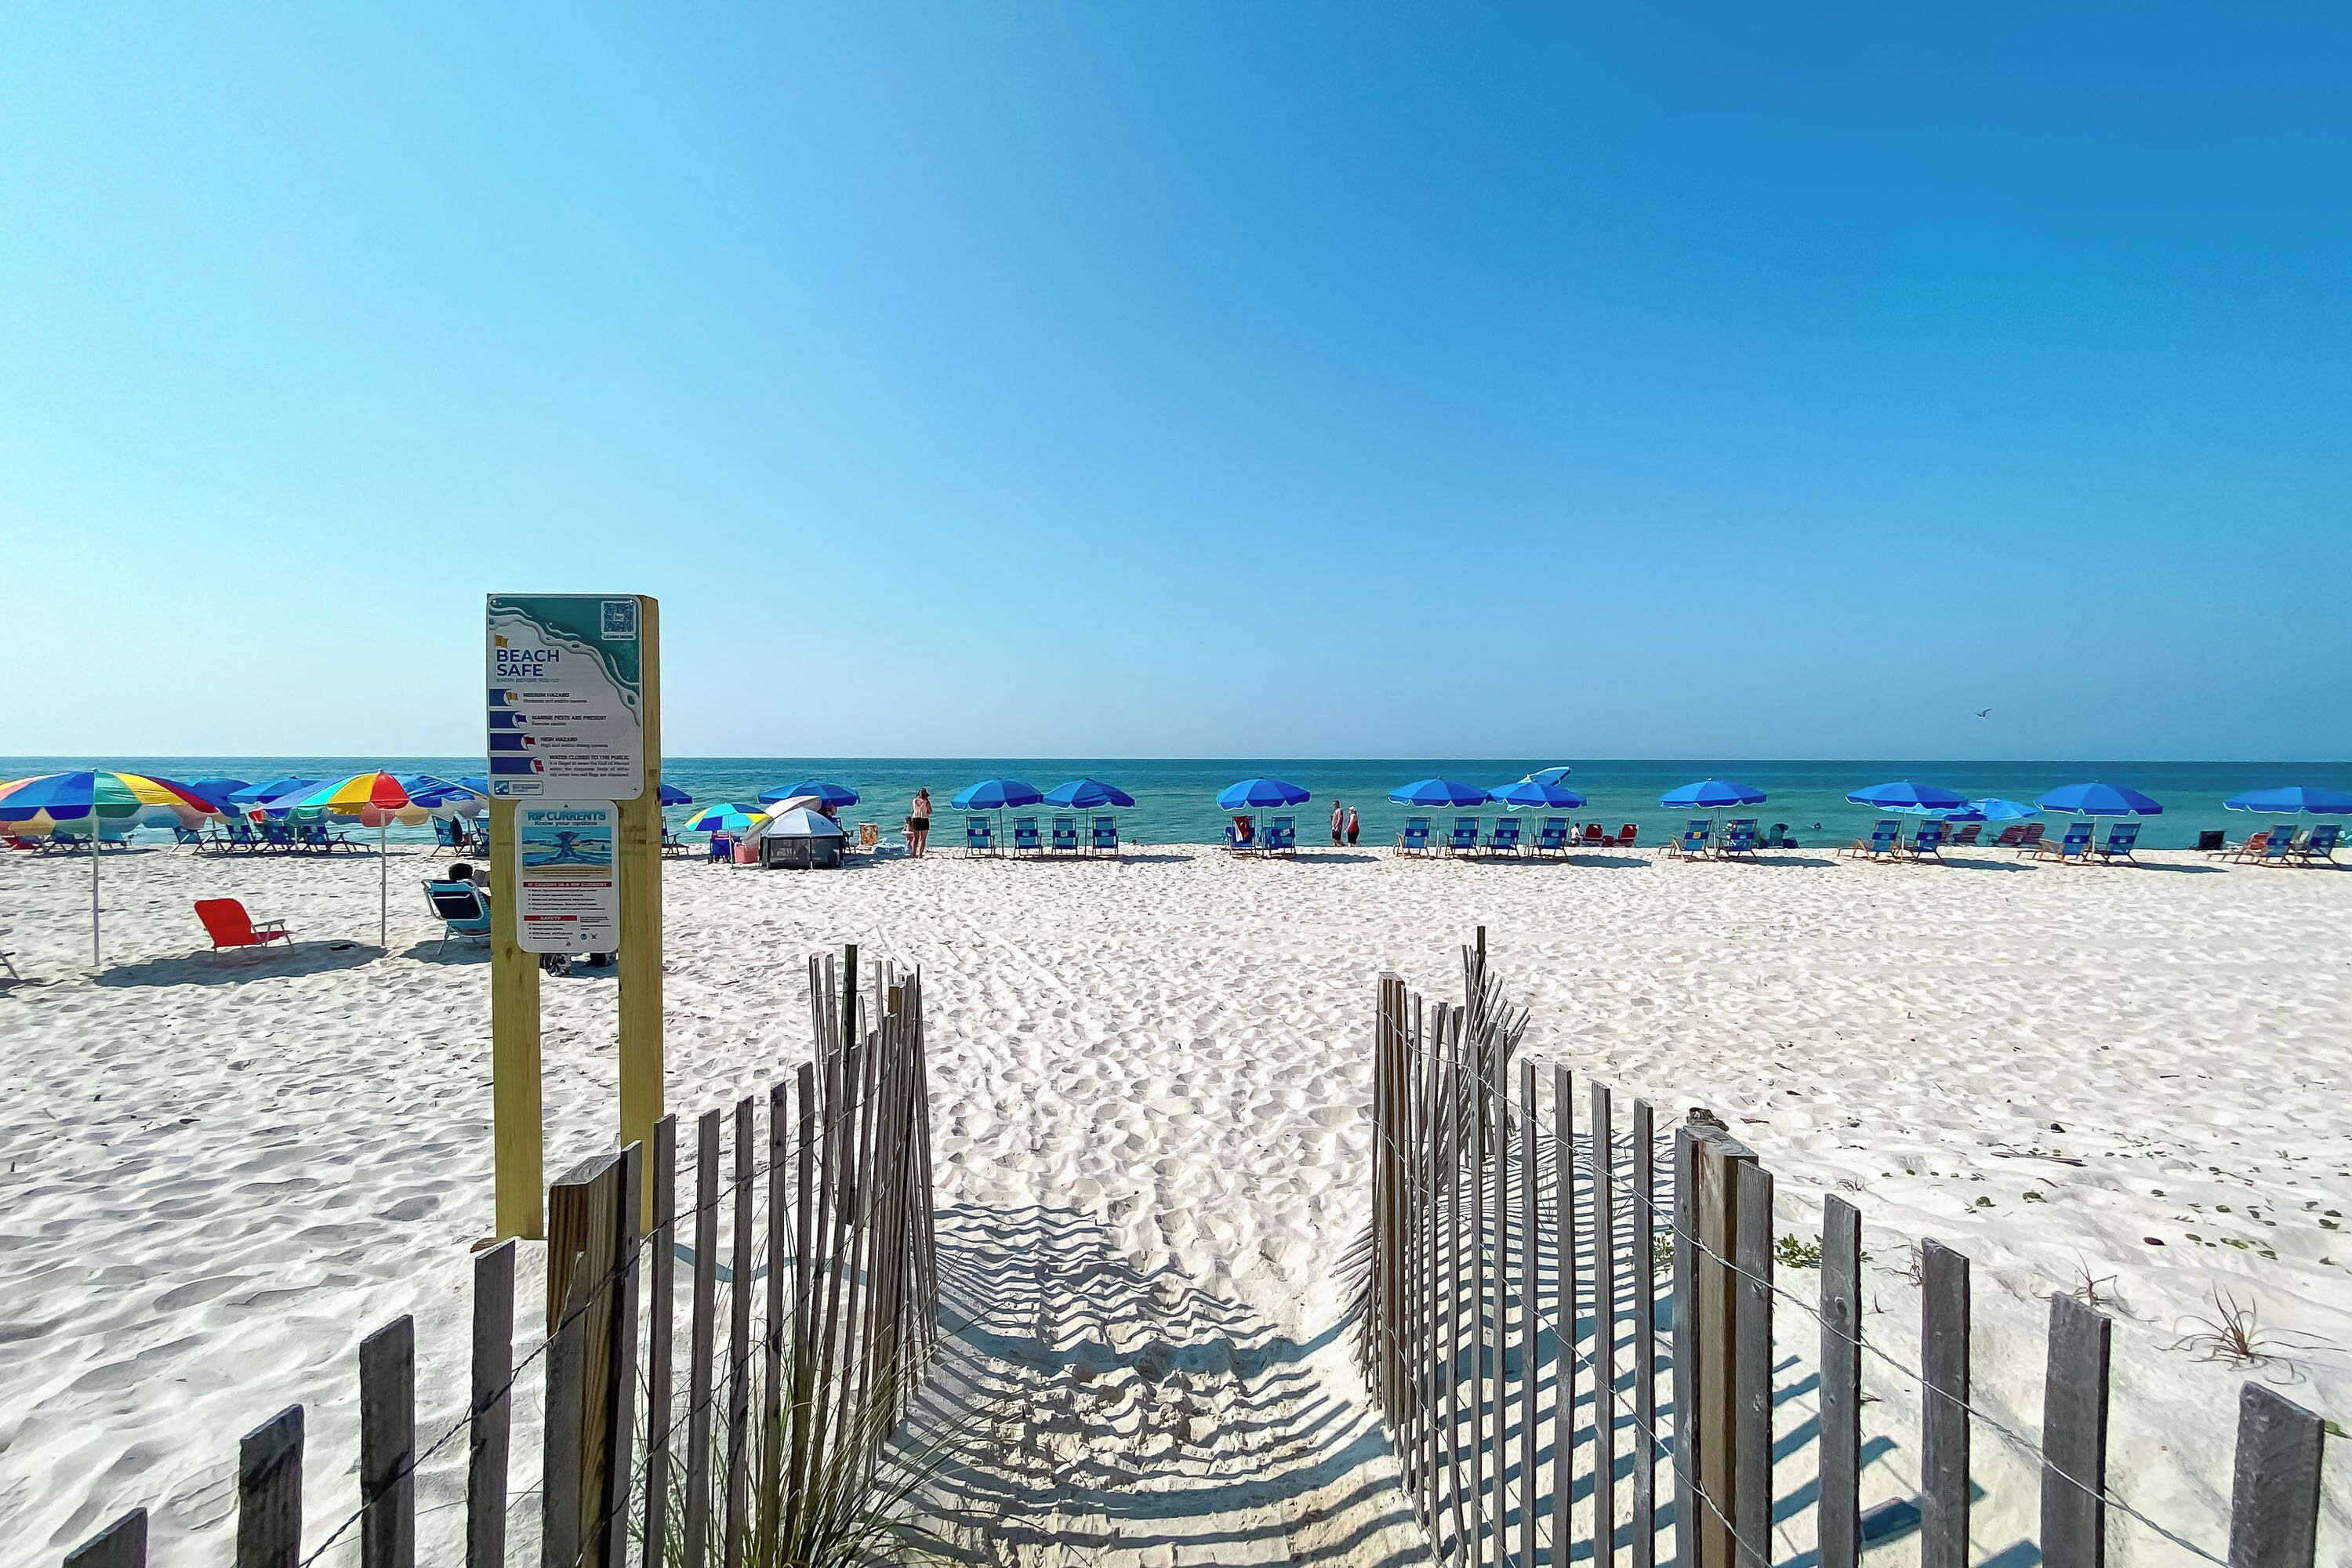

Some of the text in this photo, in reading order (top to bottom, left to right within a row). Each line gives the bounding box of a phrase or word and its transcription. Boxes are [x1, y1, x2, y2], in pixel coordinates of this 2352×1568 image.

[496, 649, 560, 662] BEACH
[496, 663, 543, 677] SAFE
[528, 811, 607, 821] RIP CURRENTS
